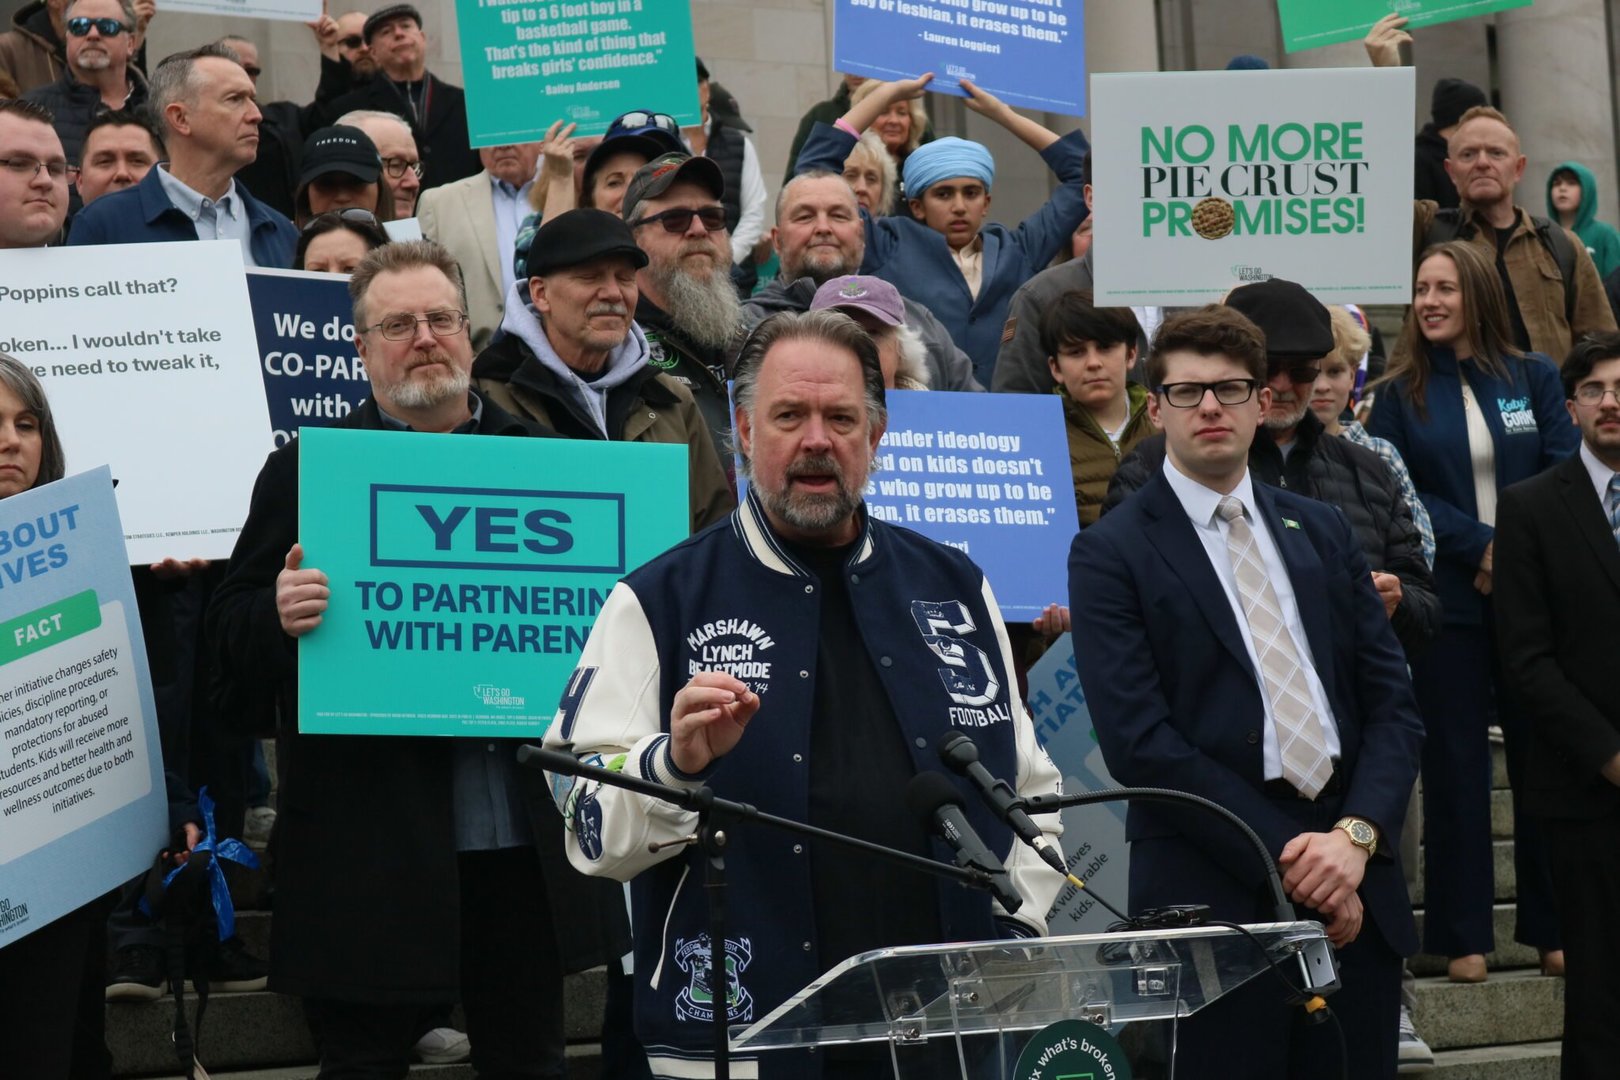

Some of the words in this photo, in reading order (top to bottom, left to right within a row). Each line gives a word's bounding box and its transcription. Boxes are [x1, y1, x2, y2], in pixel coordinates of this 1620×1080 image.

[501, 9, 520, 24] tip
[522, 8, 536, 21] to
[539, 8, 548, 20] a
[550, 4, 559, 19] 6
[561, 2, 589, 17] foot
[591, 1, 615, 16] boy
[617, 0, 632, 13] in
[633, 0, 643, 11] a
[879, 0, 895, 11] or
[897, 1, 954, 24] lesbian,
[956, 12, 968, 26] it
[970, 17, 1019, 36] erases
[972, 0, 1008, 15] grow
[1010, 6, 1029, 20] up
[1031, 8, 1046, 22] to
[1049, 11, 1067, 26] be
[516, 20, 588, 41] basketball
[590, 17, 632, 35] game.
[924, 31, 958, 46] Lauren
[528, 41, 551, 57] the
[552, 38, 583, 56] kind
[585, 37, 600, 51] of
[601, 34, 637, 51] thing
[638, 32, 666, 47] that
[492, 61, 539, 80] breaks
[1141, 124, 1215, 164] NO
[1228, 121, 1363, 163] MORE
[1140, 165, 1212, 199] PIE
[1220, 162, 1369, 196] CRUST
[0, 284, 80, 304] Poppins
[85, 281, 122, 297] call
[125, 277, 178, 295] that?
[72, 334, 78, 349] I
[83, 330, 174, 349] wouldn't
[177, 327, 222, 344] take
[273, 313, 316, 339] We
[51, 359, 103, 377] need
[107, 359, 128, 373] to
[132, 354, 196, 372] tweak
[199, 352, 220, 371] it,
[291, 393, 351, 418] with
[937, 431, 1020, 452] ideology
[899, 457, 923, 472] on
[927, 455, 968, 473] kids
[972, 456, 1043, 476] doesn't
[880, 478, 919, 497] who
[924, 482, 972, 500] grow
[976, 484, 1001, 501] up
[1004, 483, 1024, 500] to
[1028, 482, 1052, 500] be
[905, 503, 921, 522] it
[924, 508, 991, 524] erases
[415, 504, 574, 555] YES
[354, 581, 403, 611] TO
[13, 613, 62, 647] FACT
[364, 620, 462, 651] WITH
[472, 623, 594, 654] PAREN
[687, 618, 776, 652] MARSHAWN
[702, 644, 753, 662] LYNCH
[14, 674, 54, 697] initiative
[55, 658, 92, 681] changes
[93, 647, 118, 666] safety
[25, 685, 67, 712] discipline
[68, 666, 119, 697] procedures,
[4, 712, 54, 740] mandatory
[55, 692, 98, 718] reporting,
[99, 688, 109, 699] or
[11, 727, 63, 759] protections
[63, 718, 76, 732] for
[77, 704, 109, 728] abused
[38, 748, 58, 764] Kids
[58, 737, 75, 754] will
[75, 726, 106, 748] receive
[106, 715, 129, 732] more
[0, 773, 42, 799] resources
[42, 764, 60, 781] and
[61, 753, 87, 772] better
[88, 740, 116, 761] health
[116, 730, 133, 747] and
[3, 795, 42, 817] wellness
[42, 775, 86, 798] outcomes
[86, 765, 103, 780] due
[104, 759, 113, 771] to
[114, 748, 135, 767] both
[52, 788, 96, 814] initiatives.
[1058, 853, 1109, 906] vulnrable
[1068, 900, 1096, 922] kids.
[688, 1008, 739, 1019] CHAMNS
[1080, 1038, 1116, 1080] broken
